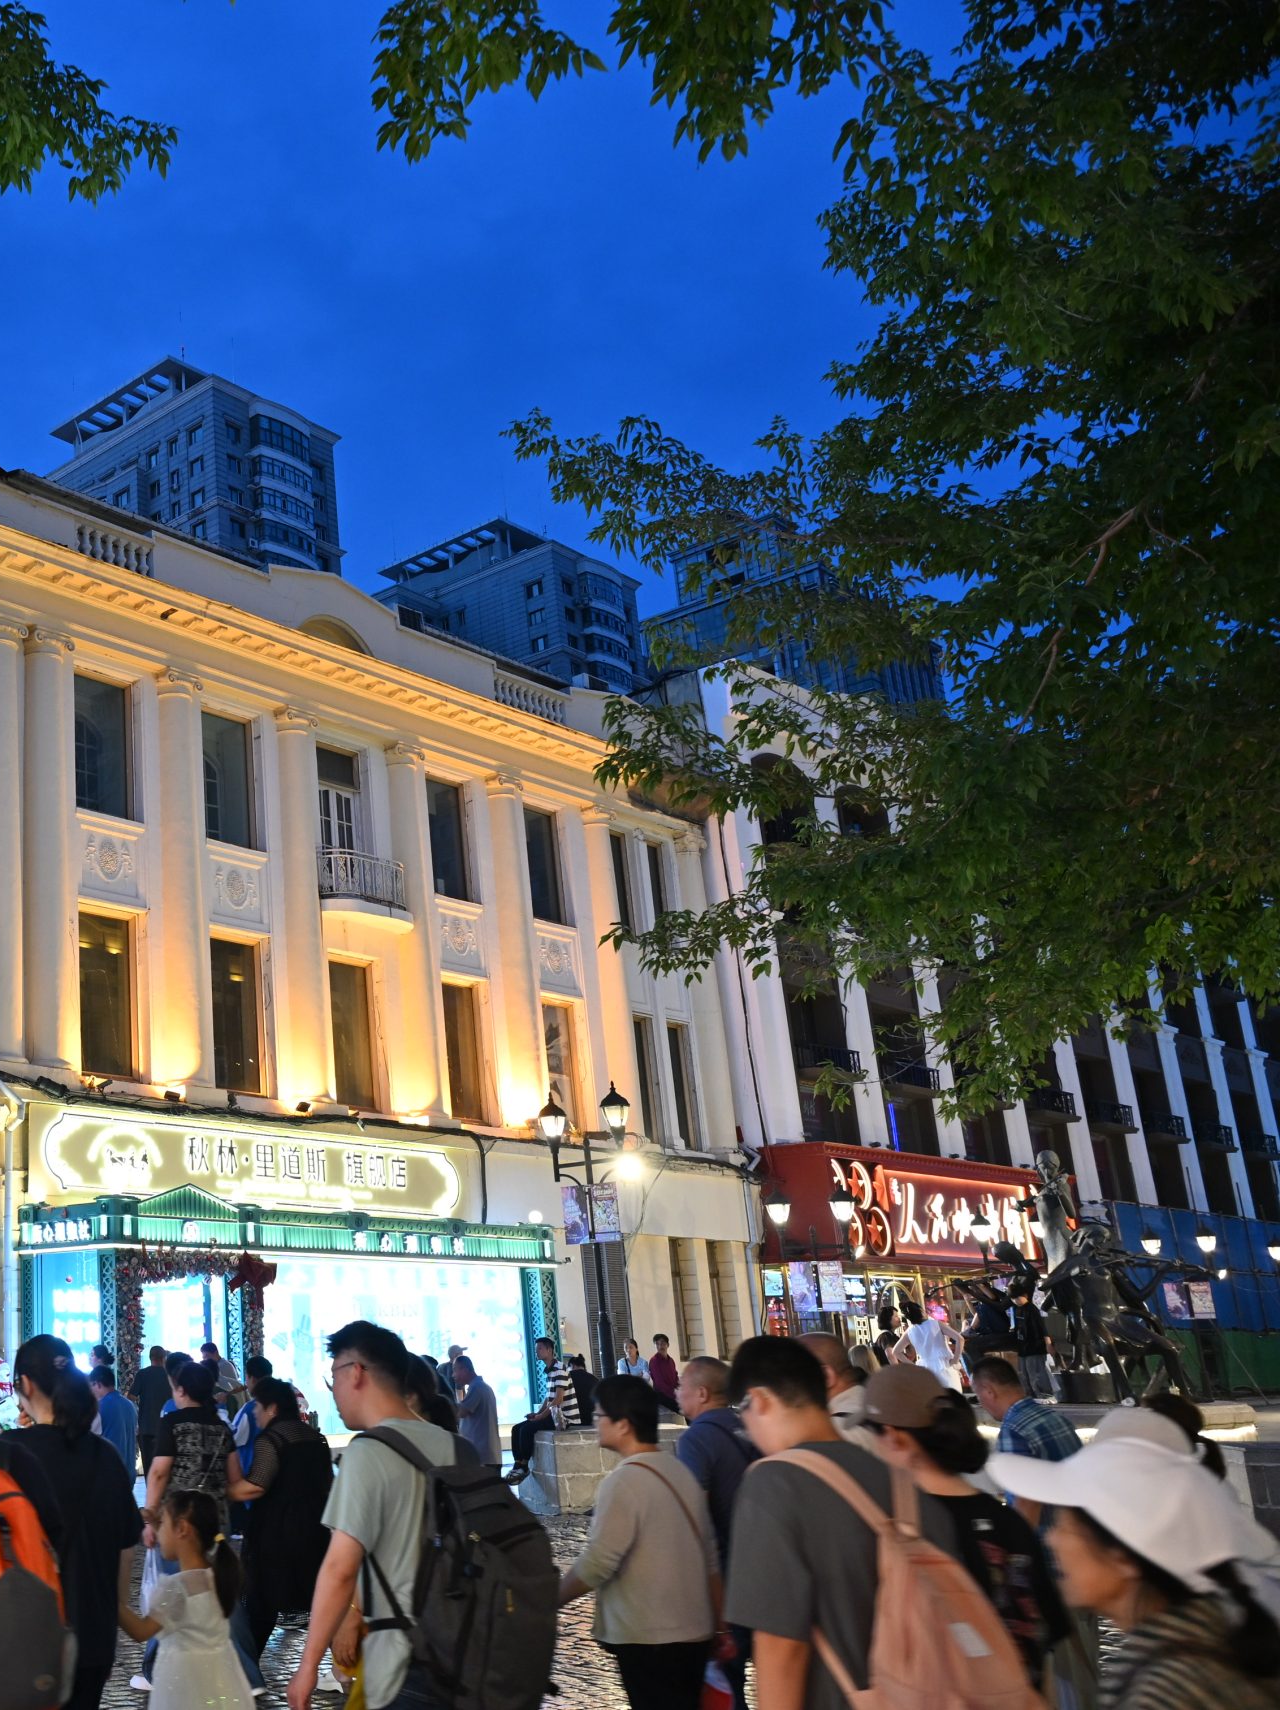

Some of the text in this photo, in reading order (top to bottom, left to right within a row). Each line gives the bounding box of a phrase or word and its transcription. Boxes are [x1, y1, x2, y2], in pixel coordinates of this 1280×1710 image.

[187, 1137, 407, 1188] 秋林·里道斯 旗舰店
